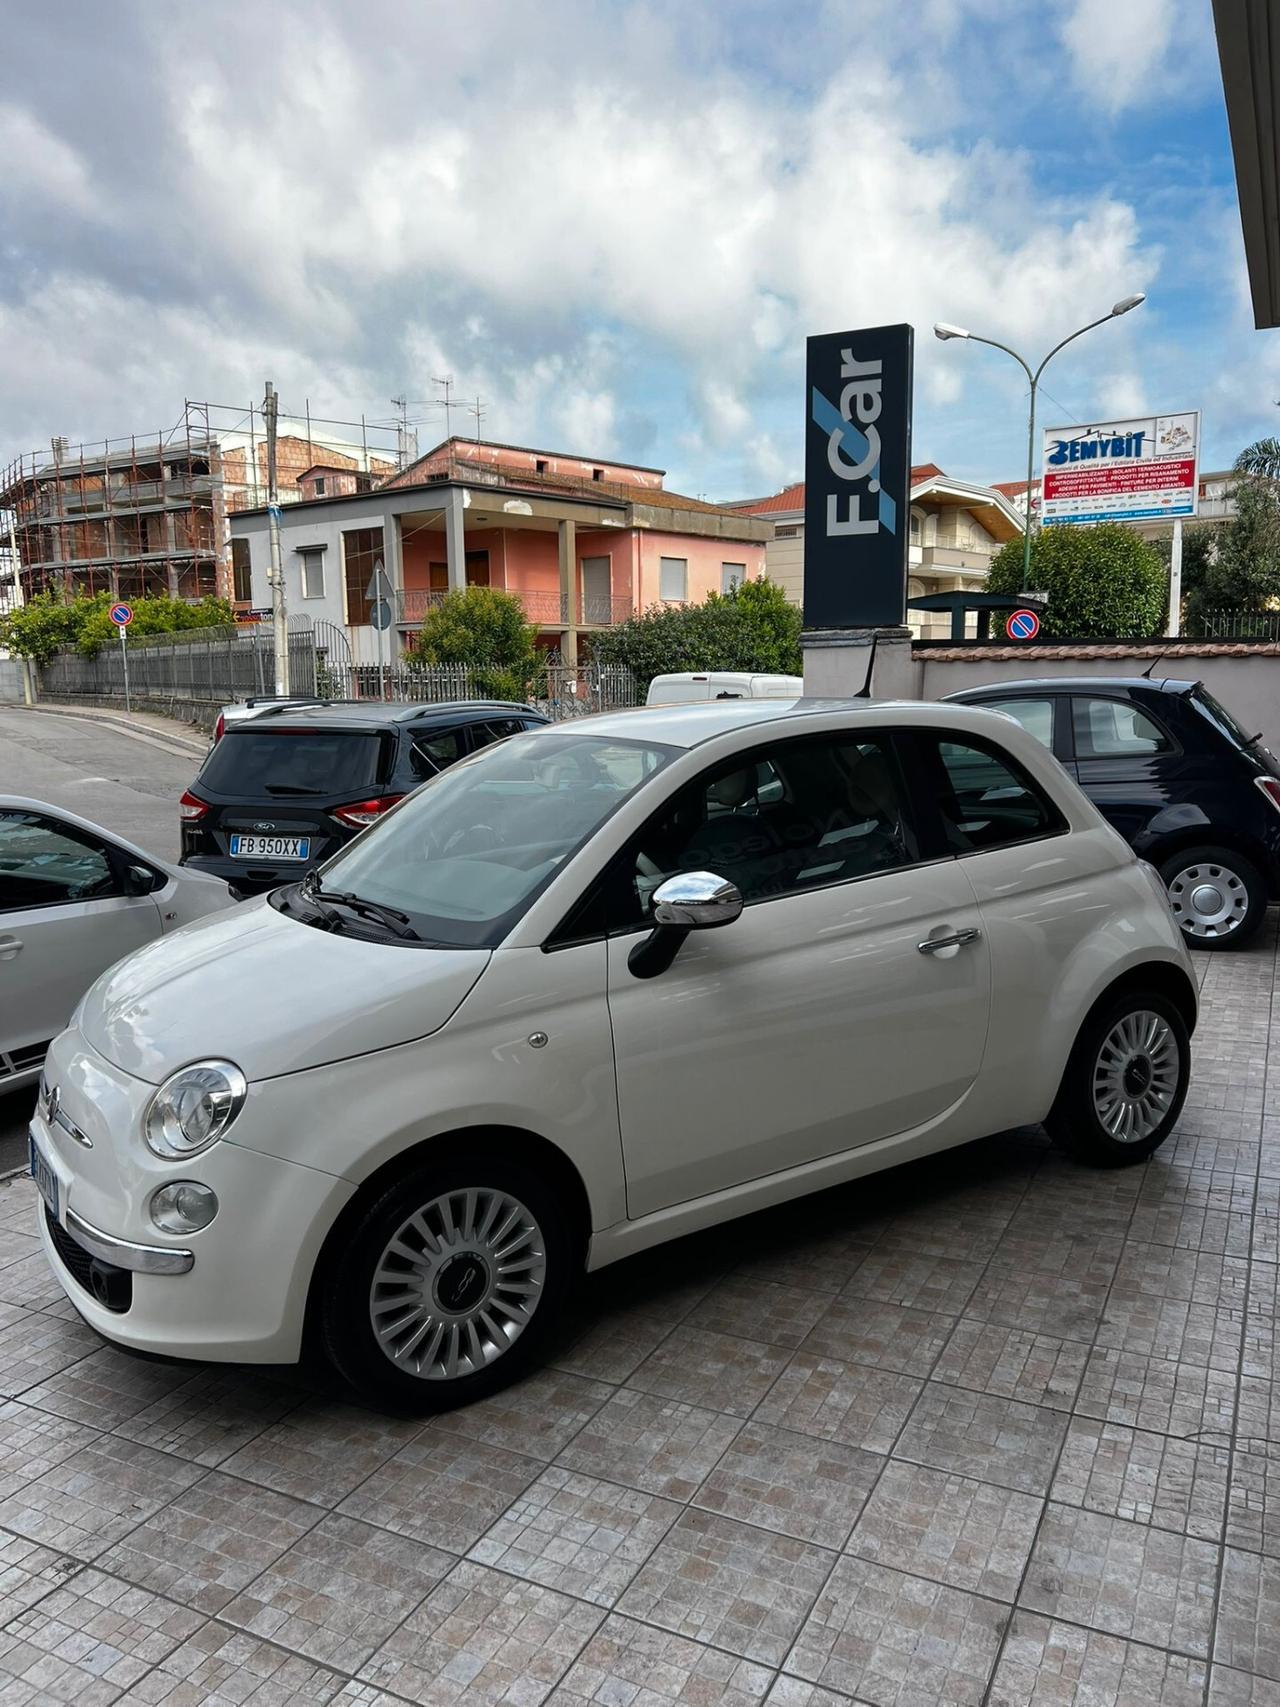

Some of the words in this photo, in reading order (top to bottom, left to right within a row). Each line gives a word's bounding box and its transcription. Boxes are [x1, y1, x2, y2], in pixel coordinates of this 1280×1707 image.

[826, 348, 883, 537] F.Car
[1150, 468, 1190, 478] RISANAMENTO
[240, 838, 254, 853] FB
[258, 838, 300, 856] 950XX
